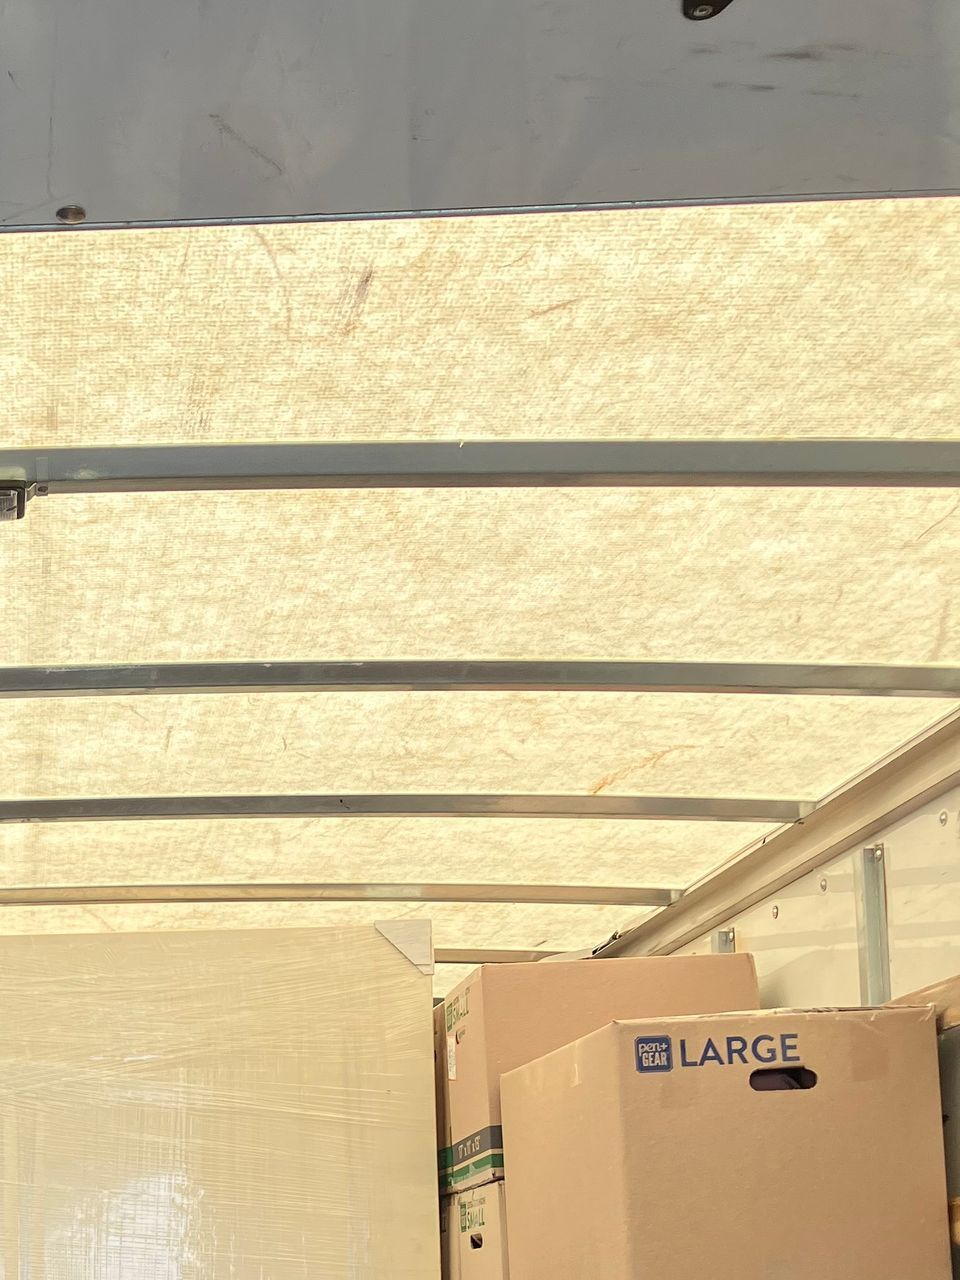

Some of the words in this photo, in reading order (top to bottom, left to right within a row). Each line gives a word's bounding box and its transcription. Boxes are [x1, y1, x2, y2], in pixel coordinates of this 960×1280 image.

[638, 1040, 668, 1056] pen+
[680, 1033, 801, 1067] LARGE
[641, 1052, 668, 1067] GEAR
